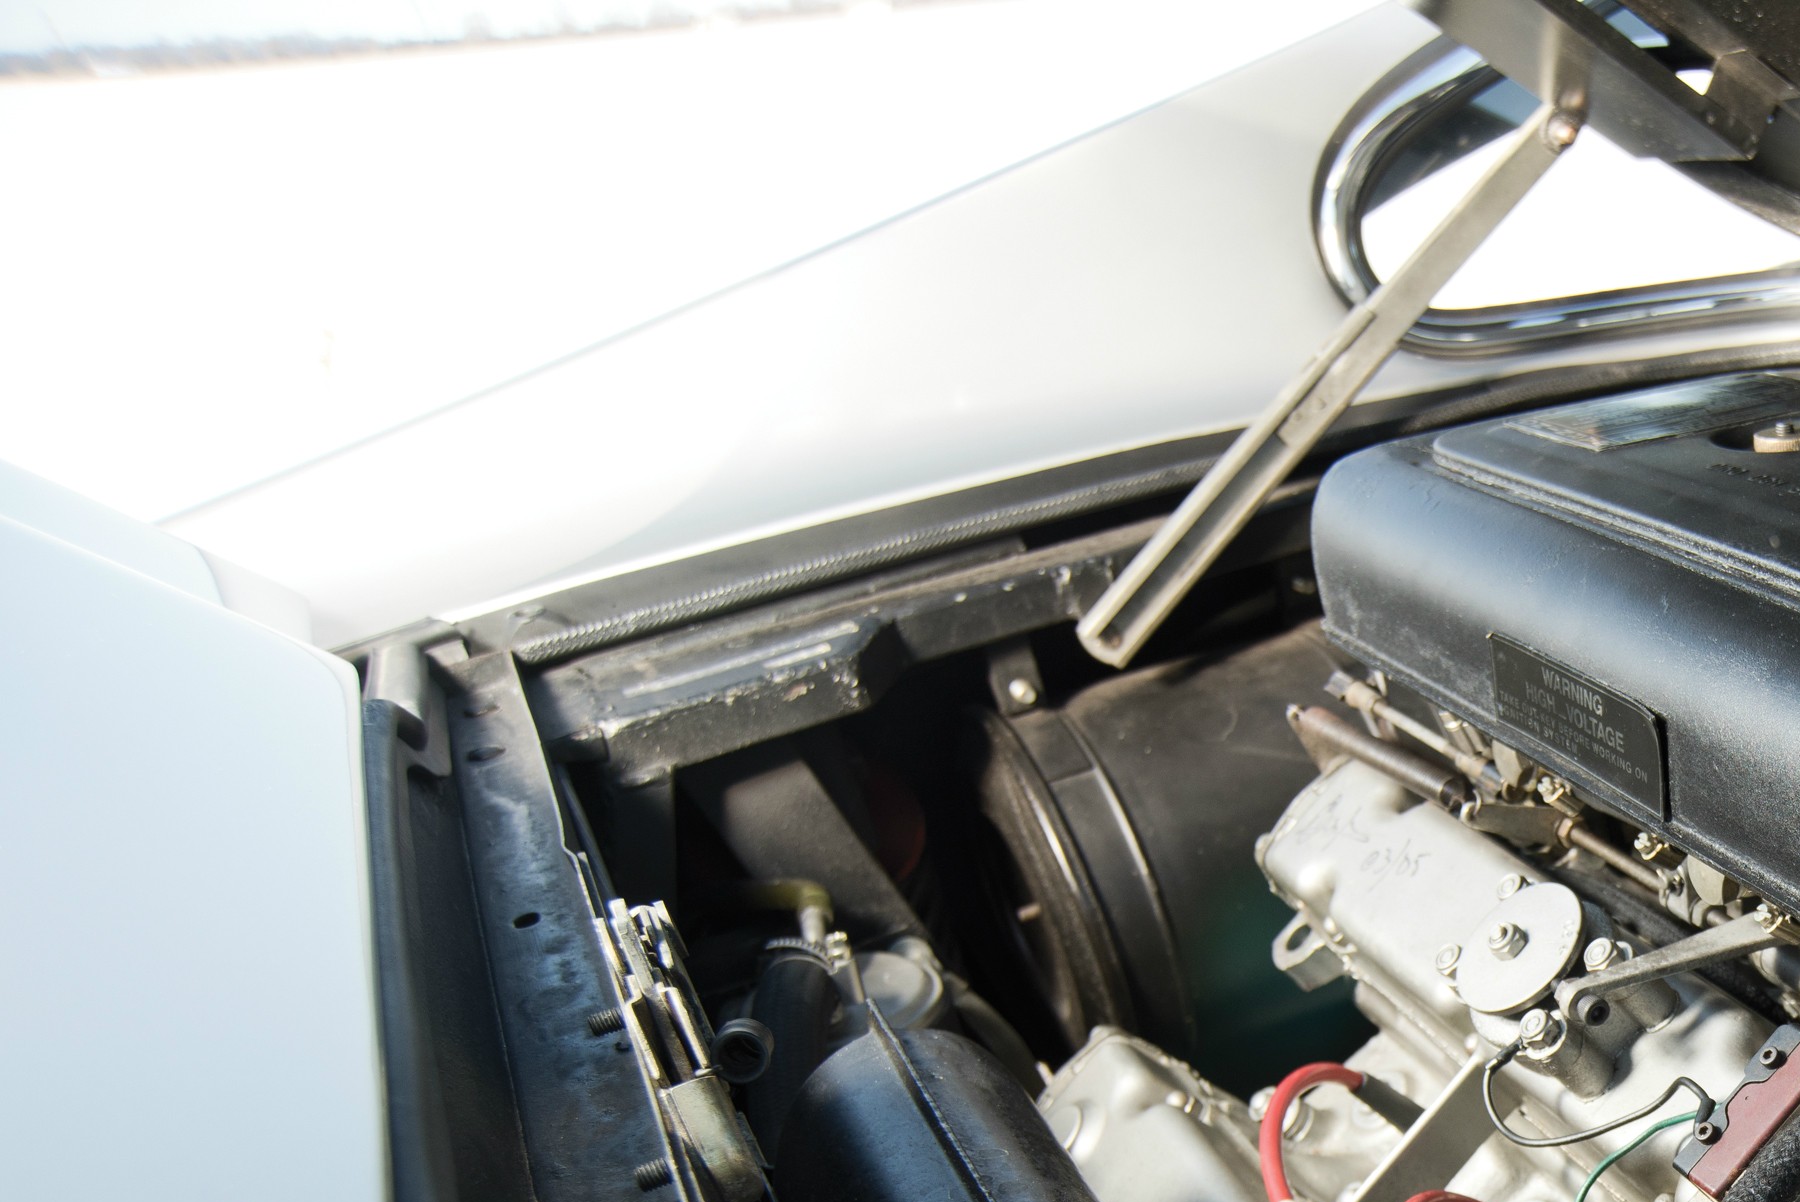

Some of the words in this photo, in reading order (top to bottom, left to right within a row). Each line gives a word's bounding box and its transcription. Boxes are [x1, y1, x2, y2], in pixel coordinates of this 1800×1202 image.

[1541, 666, 1603, 717] WARNING
[1499, 690, 1520, 710] TAKE
[1559, 721, 1590, 750] BEFORE
[1592, 740, 1632, 774] WORKING
[1634, 767, 1648, 784] ON
